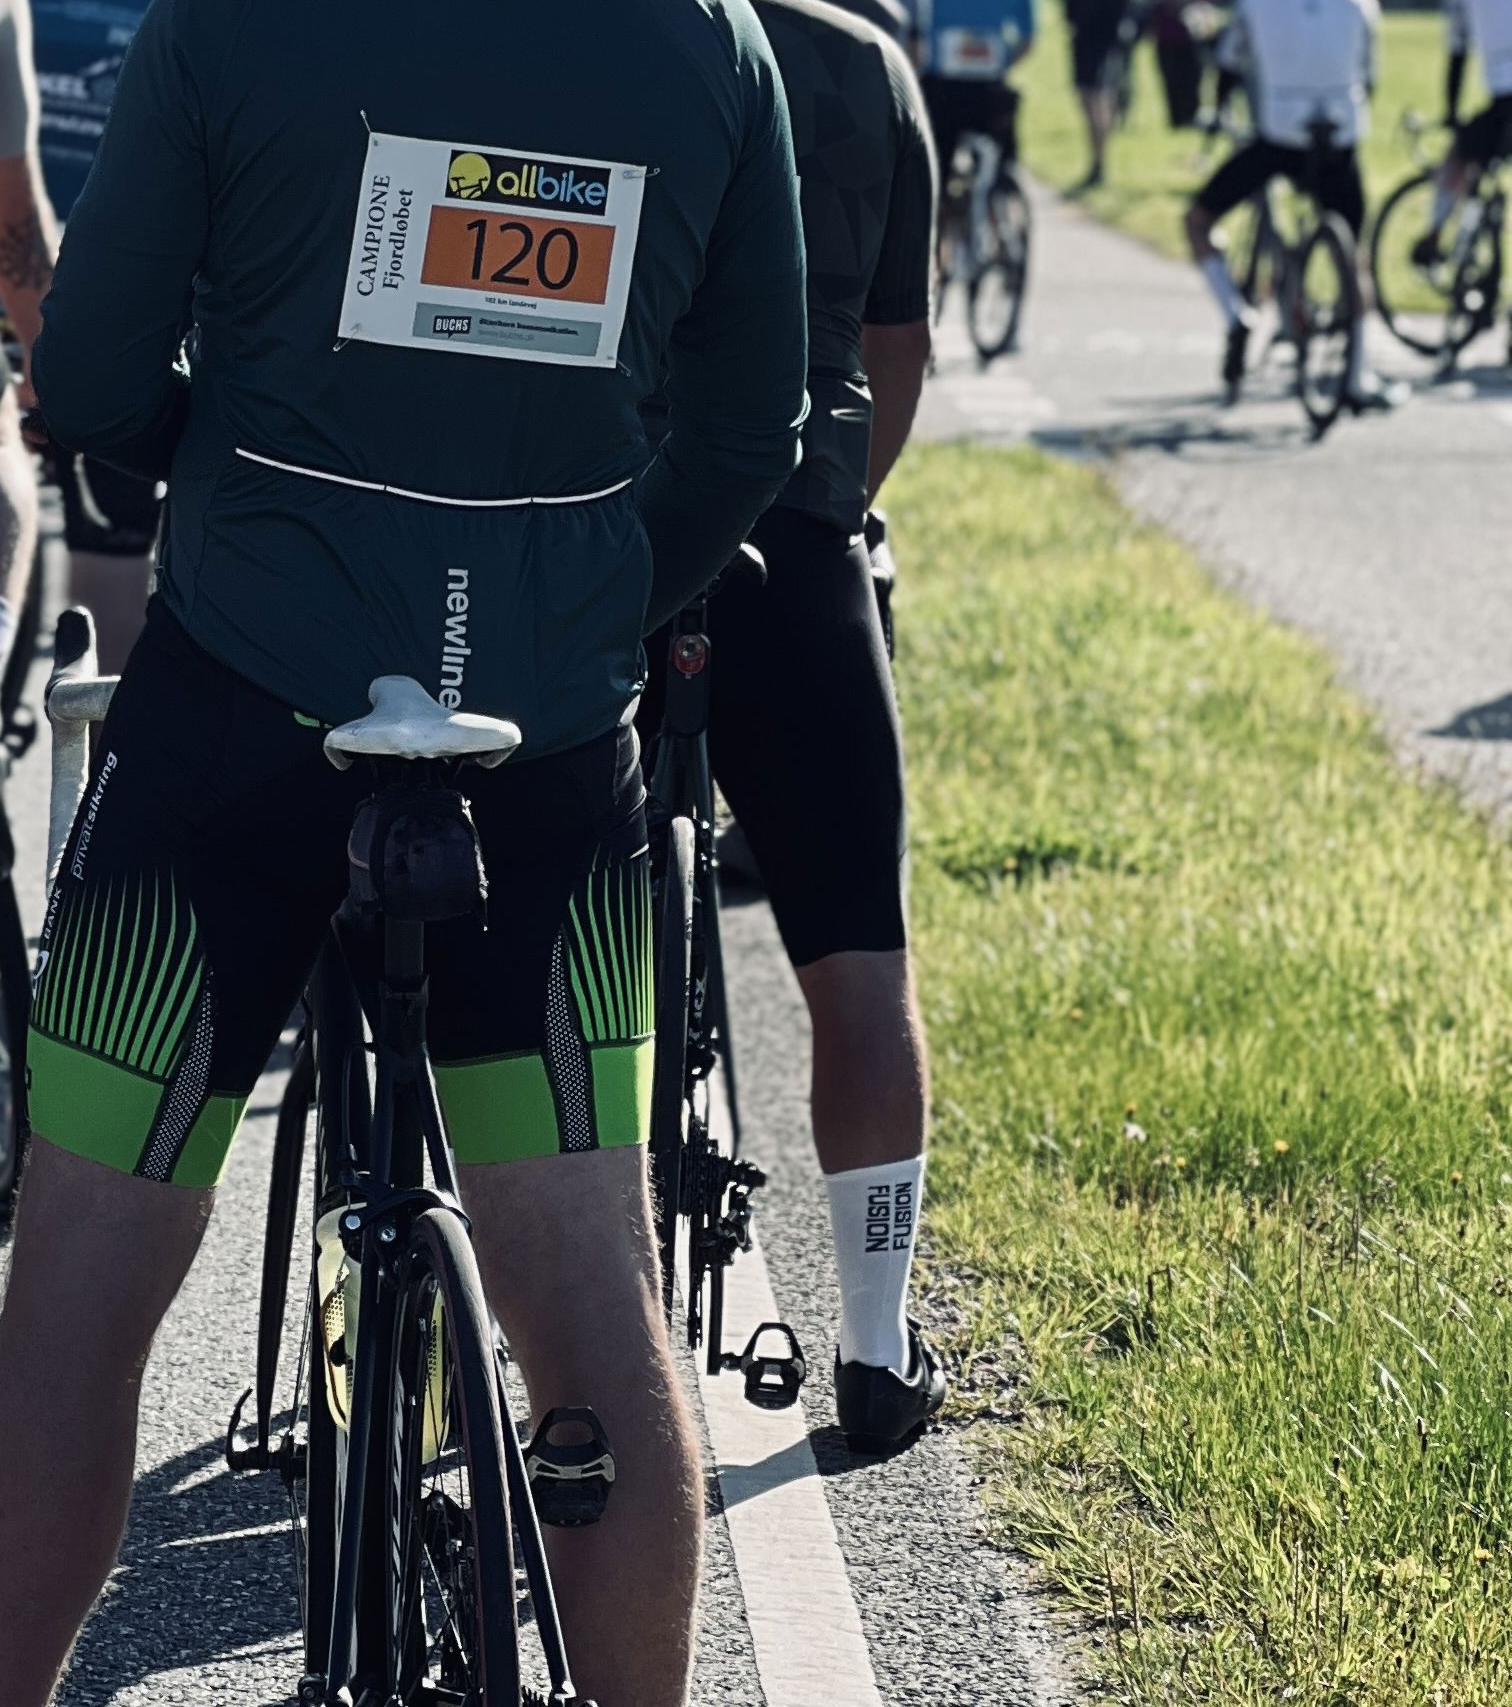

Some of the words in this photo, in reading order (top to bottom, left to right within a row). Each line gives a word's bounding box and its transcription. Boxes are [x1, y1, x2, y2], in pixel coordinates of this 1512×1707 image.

[496, 163, 608, 206] allbike
[356, 174, 391, 297] CAMPIONE
[382, 188, 414, 291] Fjordløbet
[466, 218, 580, 291] 120
[436, 318, 469, 332] BUCHS
[438, 568, 472, 710] newline
[70, 750, 119, 882] privatsikring
[43, 887, 64, 941] BANK
[865, 1184, 891, 1253] FUSION
[892, 1181, 913, 1251] FUSION
